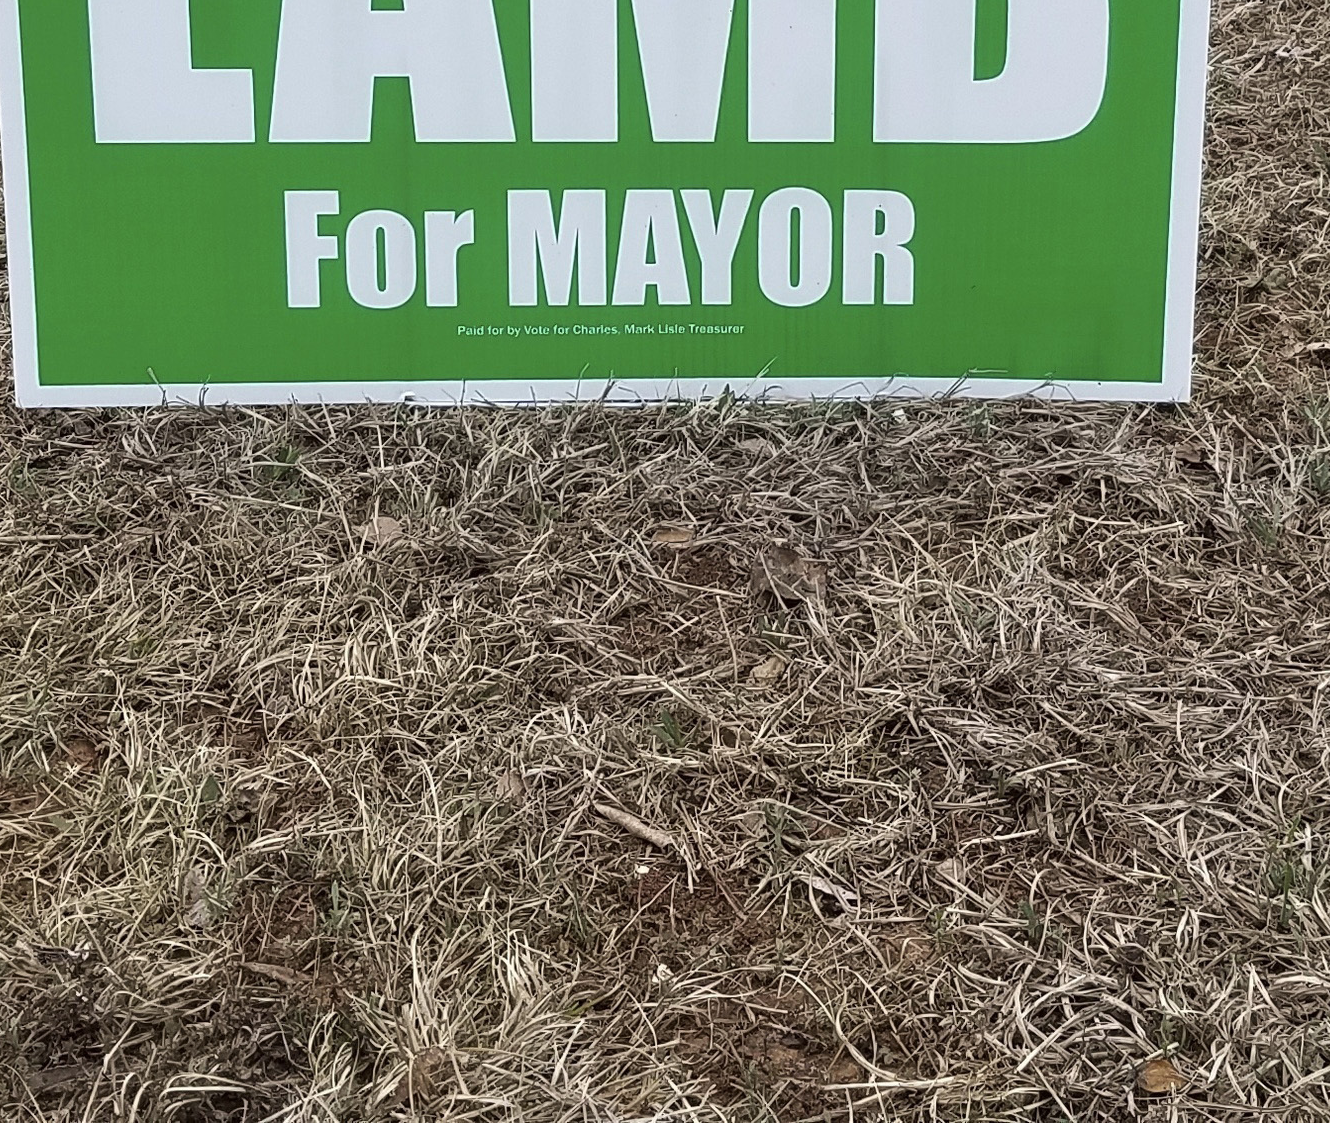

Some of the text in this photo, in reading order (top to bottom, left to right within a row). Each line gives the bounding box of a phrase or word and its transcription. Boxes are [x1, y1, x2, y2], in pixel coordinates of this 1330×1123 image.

[284, 187, 916, 308] For MAYOR
[457, 325, 484, 336] Paid
[487, 325, 504, 335] for
[507, 325, 521, 337] by
[524, 325, 550, 335] Vote
[553, 324, 569, 335] for
[624, 324, 655, 334] Mark
[658, 324, 685, 334] Lisle
[689, 323, 745, 334] Treasurer
